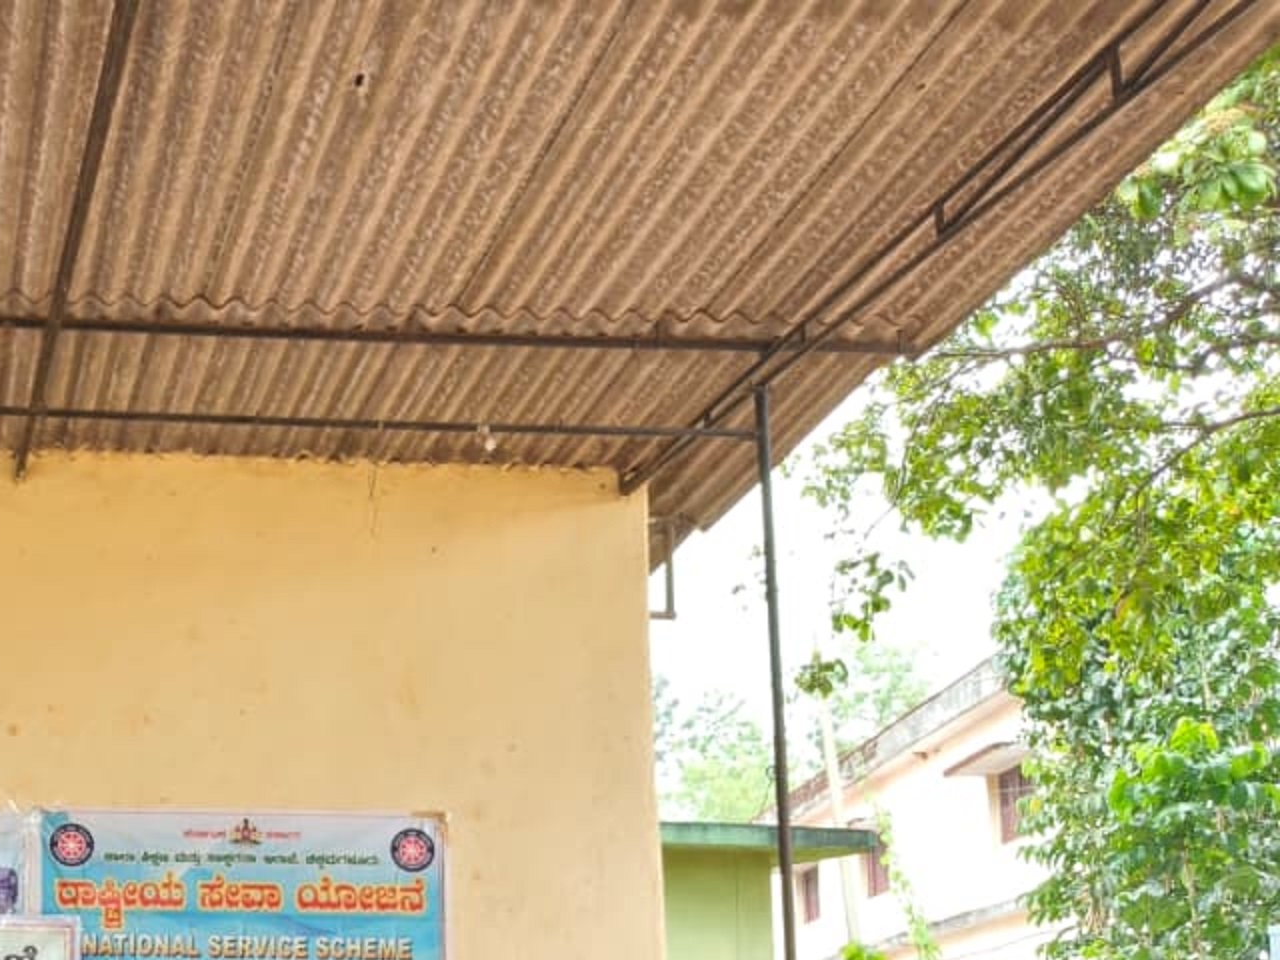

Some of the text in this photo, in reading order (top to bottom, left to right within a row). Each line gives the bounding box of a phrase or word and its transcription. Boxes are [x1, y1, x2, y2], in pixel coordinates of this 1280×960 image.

[56, 872, 426, 928] ರಾಷ್ಟ್ರೀಯ ಸೇವಾ ಯೋಜನೆ
[81, 932, 413, 960] NATIONAL SERVICE SCHEME
